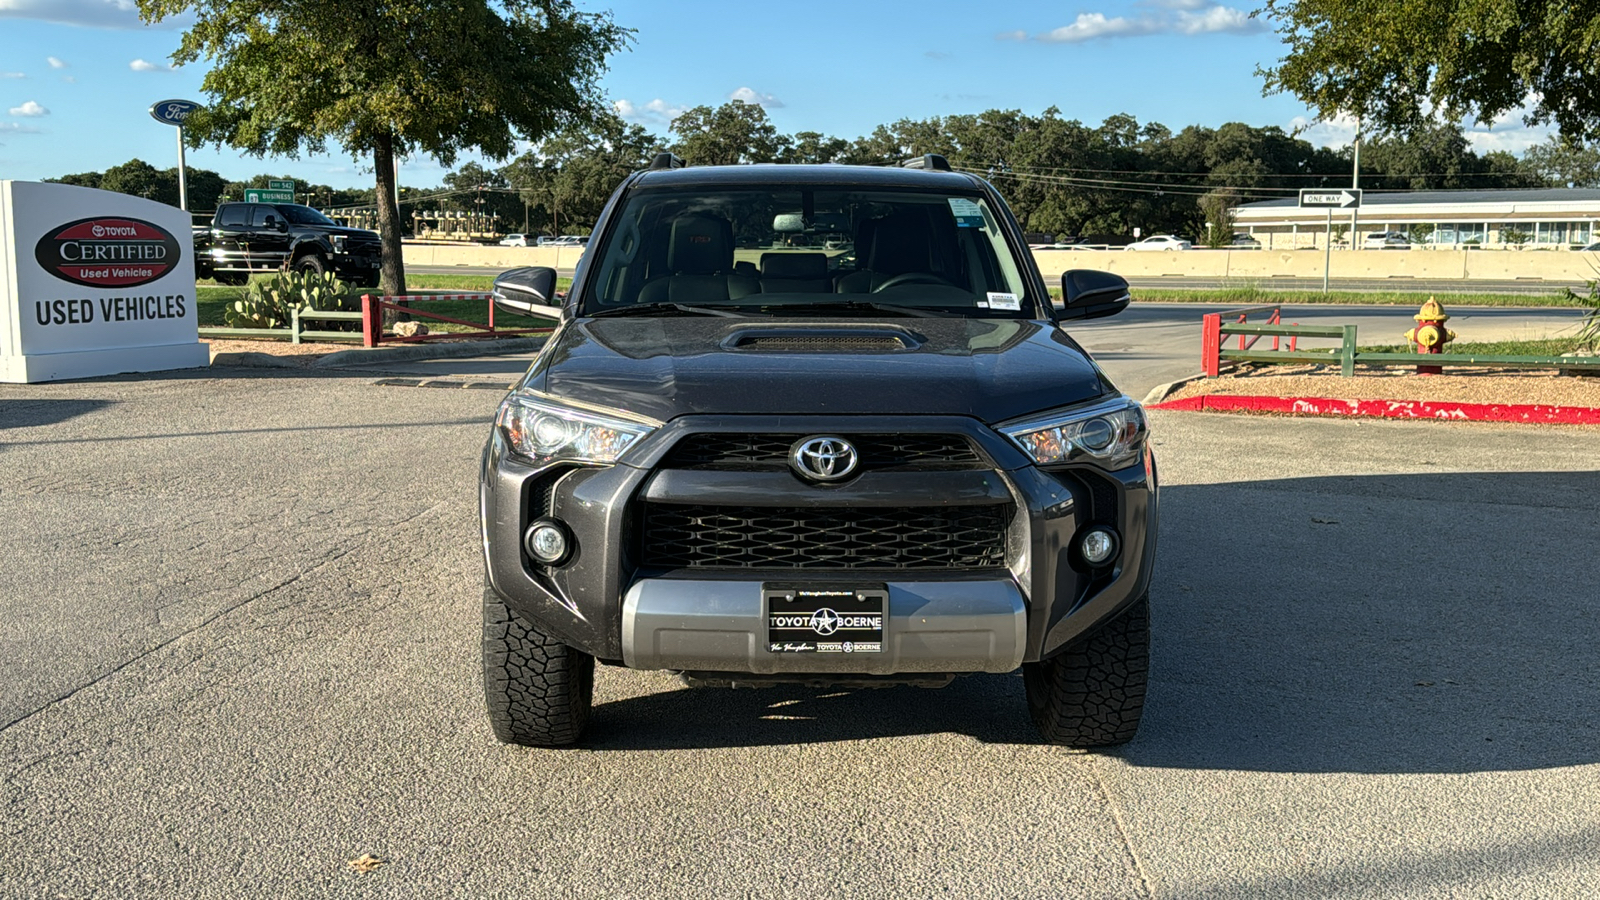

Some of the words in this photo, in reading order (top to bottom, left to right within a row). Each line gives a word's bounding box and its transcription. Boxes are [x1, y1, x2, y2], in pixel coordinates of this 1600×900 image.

[104, 226, 137, 236] TOYOTA
[59, 241, 166, 261] CERTIFIED
[80, 268, 109, 279] Used
[111, 267, 153, 278] Vehicles
[35, 299, 94, 326] USED
[100, 294, 186, 322] VEHICLES
[769, 616, 818, 627] TOYOTA
[837, 616, 882, 627] BOERNE
